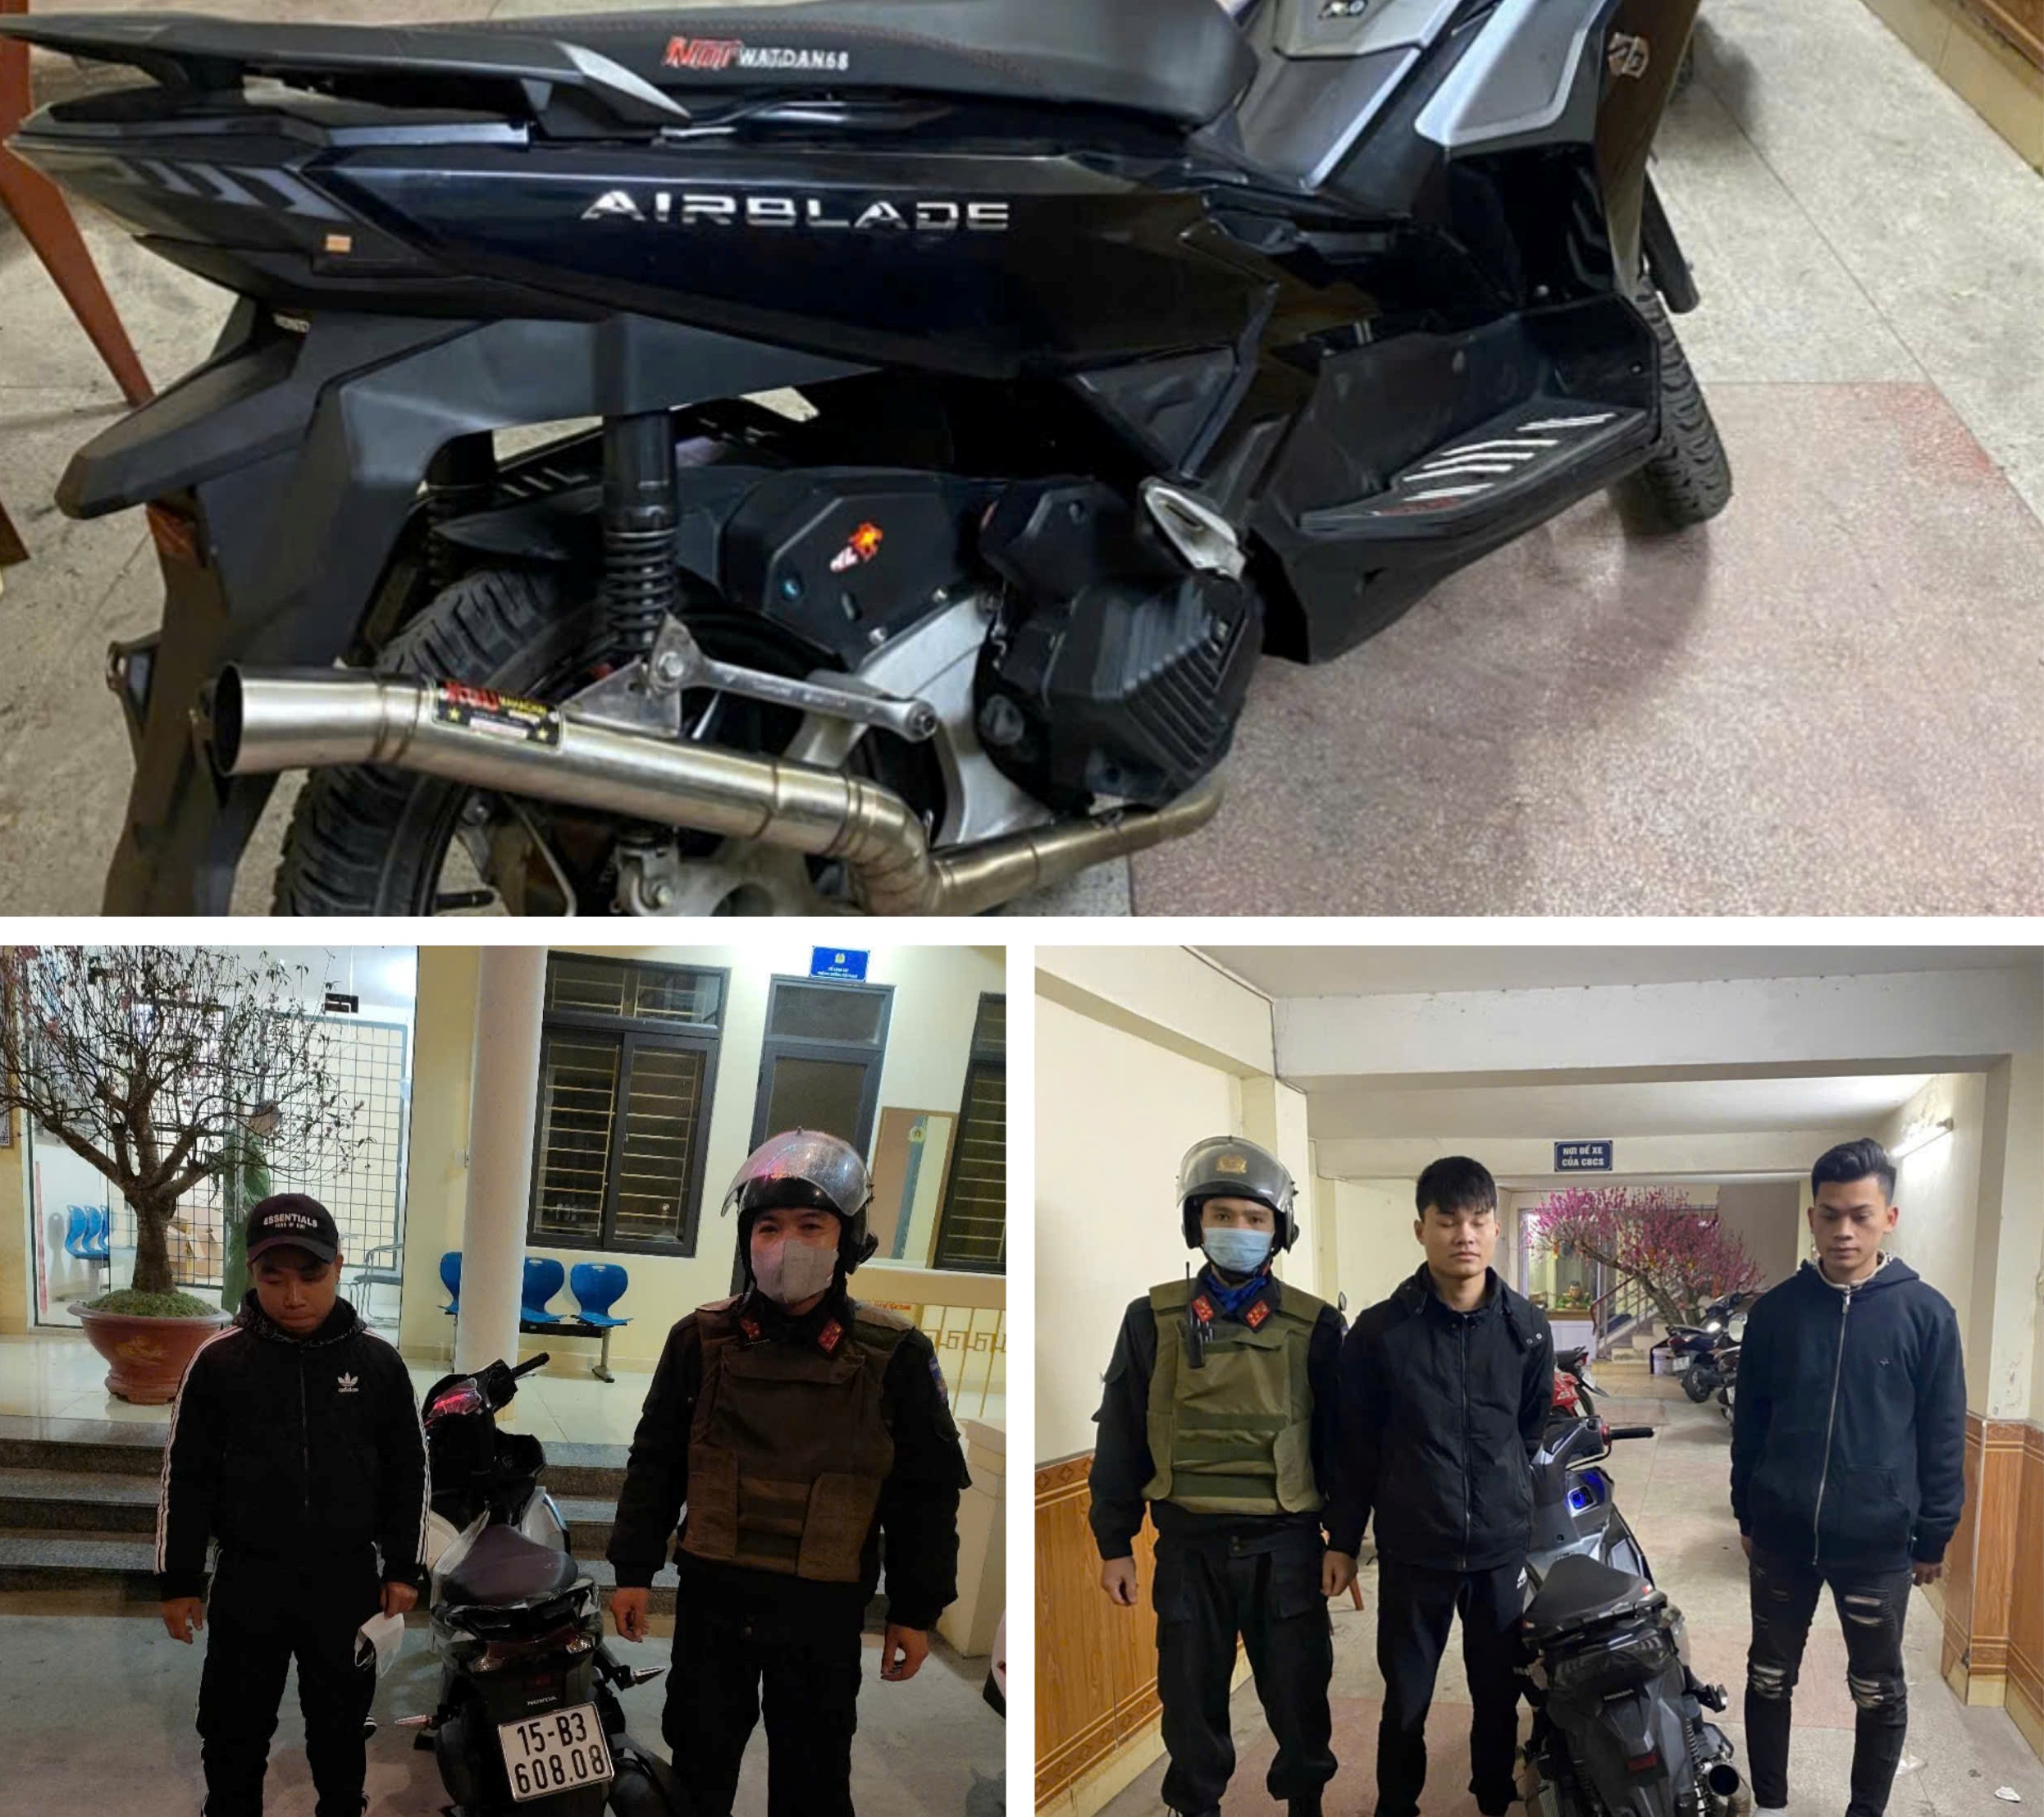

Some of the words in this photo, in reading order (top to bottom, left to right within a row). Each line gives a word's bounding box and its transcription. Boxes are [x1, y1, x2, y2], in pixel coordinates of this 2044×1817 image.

[581, 190, 1009, 230] AIRBLADE
[1562, 1156, 1580, 1166] CỦA
[1591, 1146, 1604, 1155] XE
[263, 1213, 318, 1229] ESSENTIALS
[517, 1712, 587, 1756] 15-B3
[514, 1744, 605, 1795] 608.08
